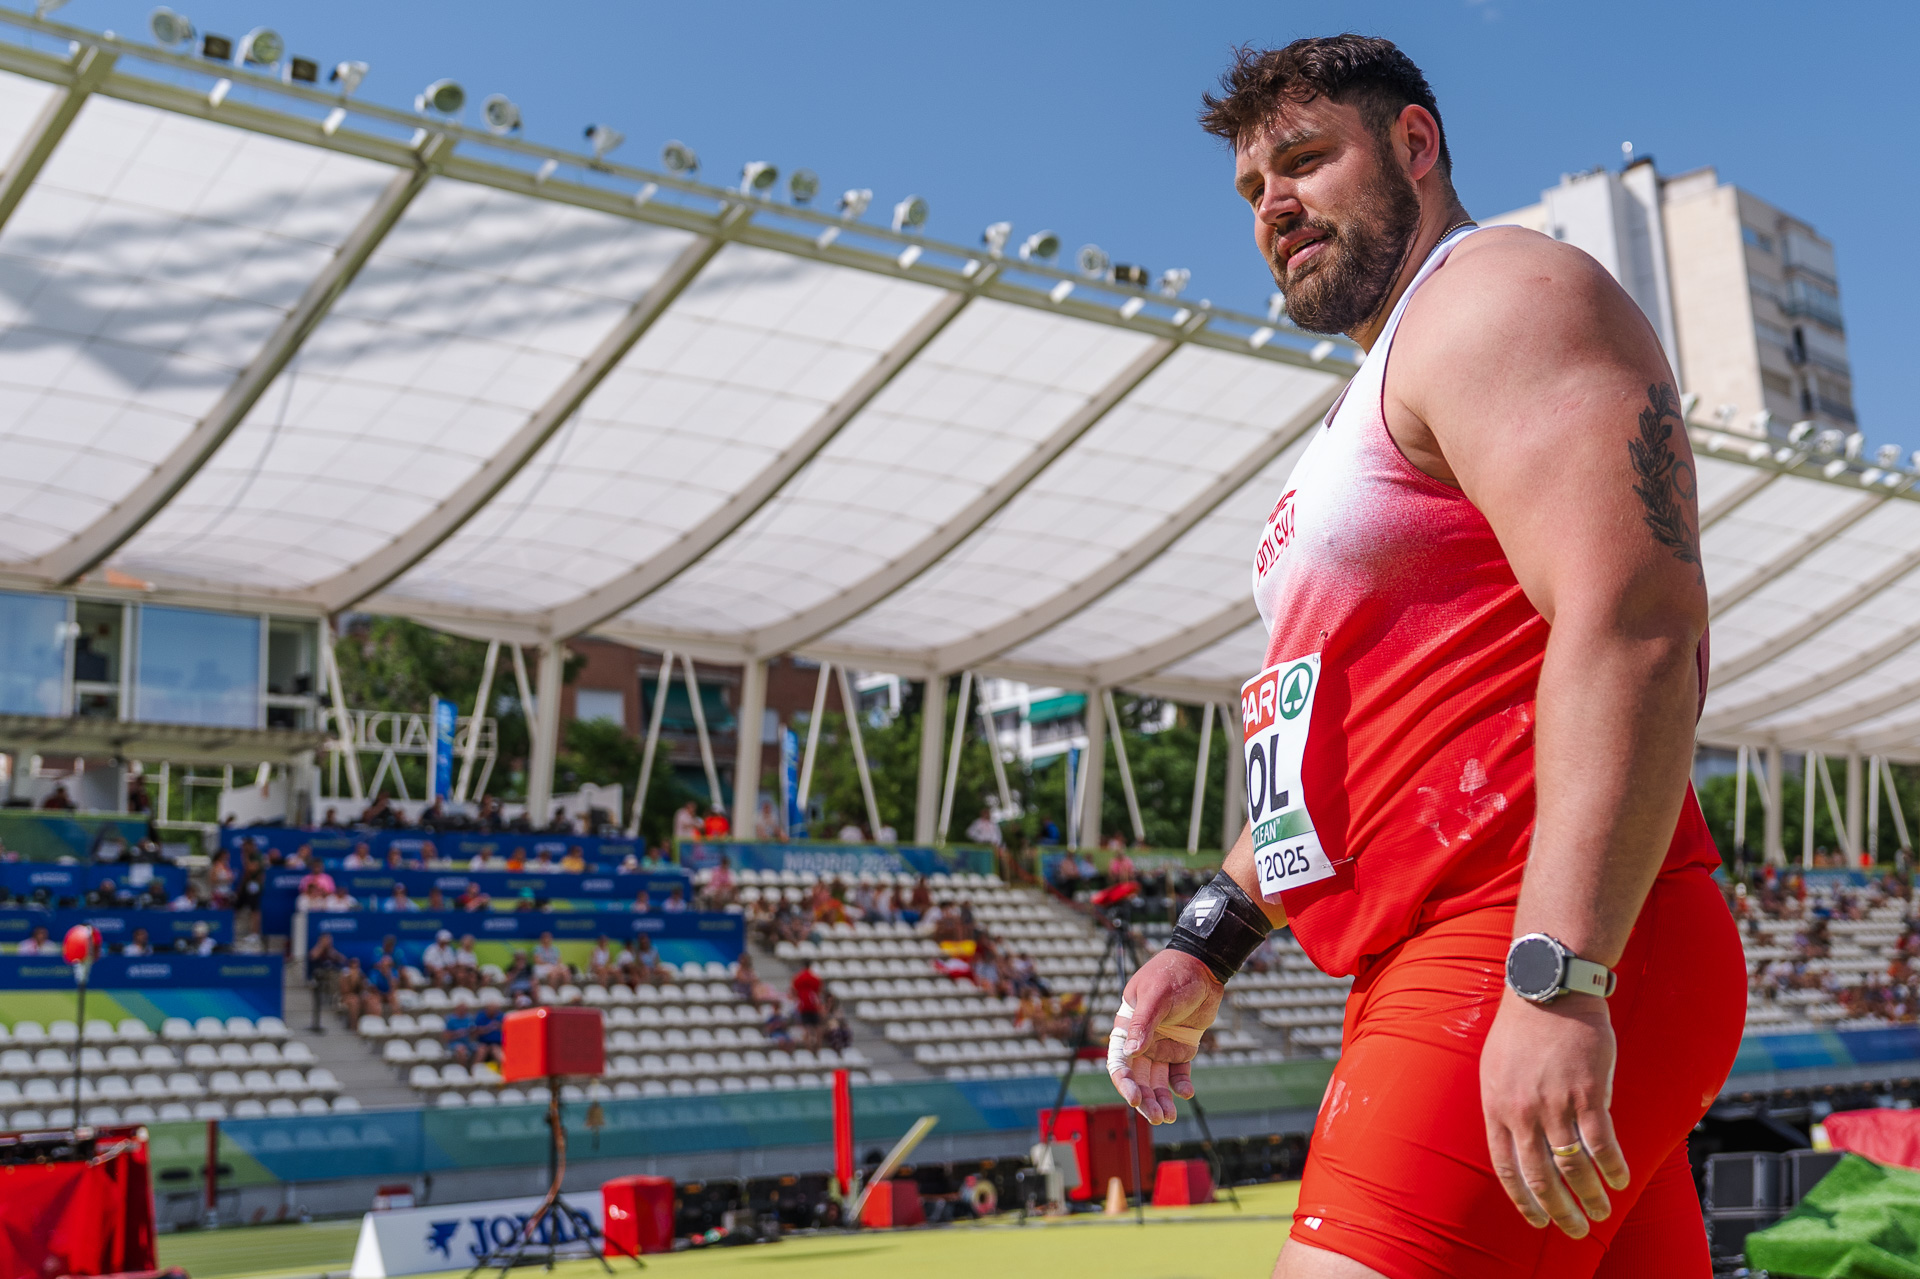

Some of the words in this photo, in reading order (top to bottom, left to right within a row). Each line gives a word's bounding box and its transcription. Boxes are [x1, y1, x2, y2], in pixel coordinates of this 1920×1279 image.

[1256, 502, 1295, 588] POLSKA
[1246, 733, 1289, 823] OL
[1264, 845, 1311, 882] 2025
